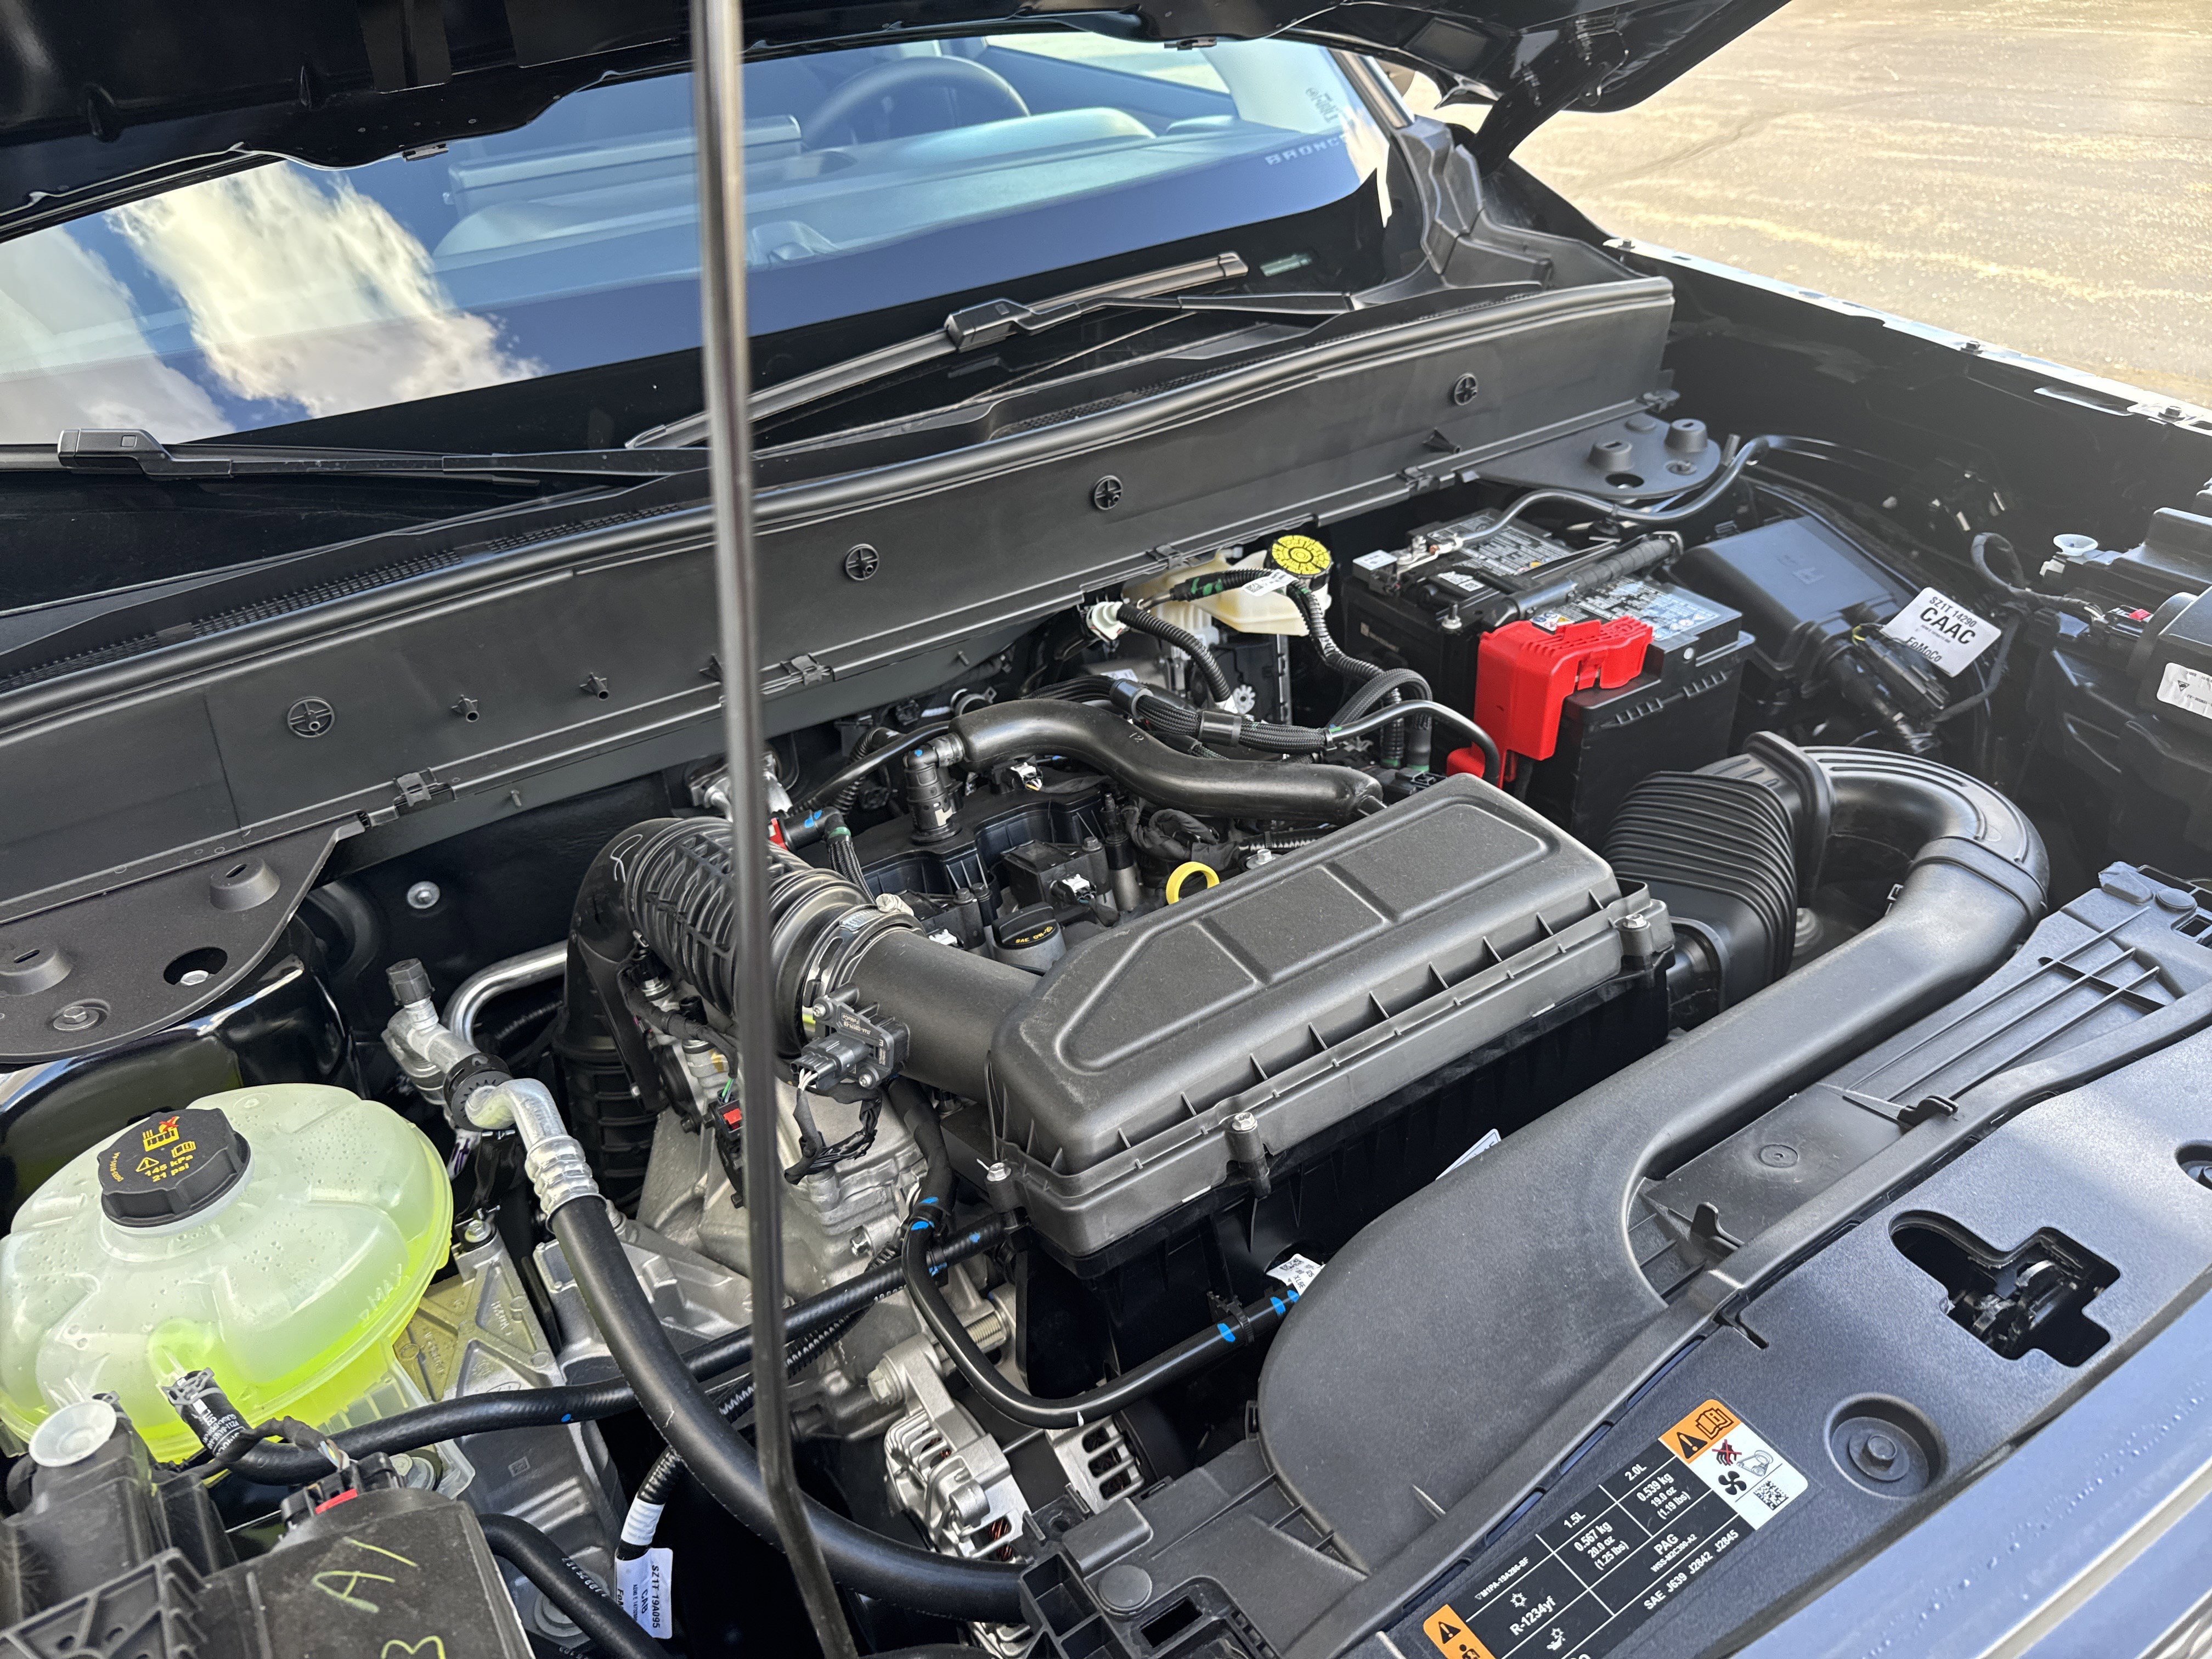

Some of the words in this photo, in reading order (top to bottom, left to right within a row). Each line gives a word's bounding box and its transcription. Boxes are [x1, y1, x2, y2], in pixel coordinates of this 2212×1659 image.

[1264, 133, 1347, 165] BRONC
[1920, 607, 1976, 644] CAAC
[1929, 596, 1953, 612] SZ1T
[1952, 611, 1977, 628] 14290
[1905, 636, 1942, 662] FoMoCo
[145, 1164, 167, 1176] 145
[170, 1155, 193, 1167] kPa
[153, 1172, 167, 1182] 21
[171, 1163, 189, 1176] psi
[366, 1263, 402, 1311] MAX
[202, 1409, 217, 1427] BTL
[1625, 1464, 1647, 1481] 2.0L
[1637, 1481, 1661, 1502] 0.539
[1657, 1473, 1674, 1485] kg
[1651, 1493, 1667, 1507] 19.0
[1666, 1486, 1677, 1497] oz
[1564, 1511, 1587, 1528] 1.5L
[1657, 1502, 1677, 1520] (1.19
[1672, 1491, 1691, 1505] lbs)
[1574, 1530, 1598, 1551] 0.567
[1596, 1521, 1613, 1534] kg
[1587, 1542, 1605, 1559] 20.0
[1604, 1536, 1616, 1546] oz
[1654, 1534, 1679, 1555] PAG
[1594, 1551, 1614, 1571] (1.25
[1610, 1541, 1629, 1556] lbs)
[1644, 1590, 1667, 1610] SAE
[1666, 1573, 1688, 1593] J639
[1688, 1551, 1714, 1575] J2842
[1714, 1530, 1739, 1553] J2845
[651, 1565, 659, 1591] SZ1T
[652, 1594, 661, 1628] 19A095
[1509, 1595, 1556, 1636] R-1234yf
